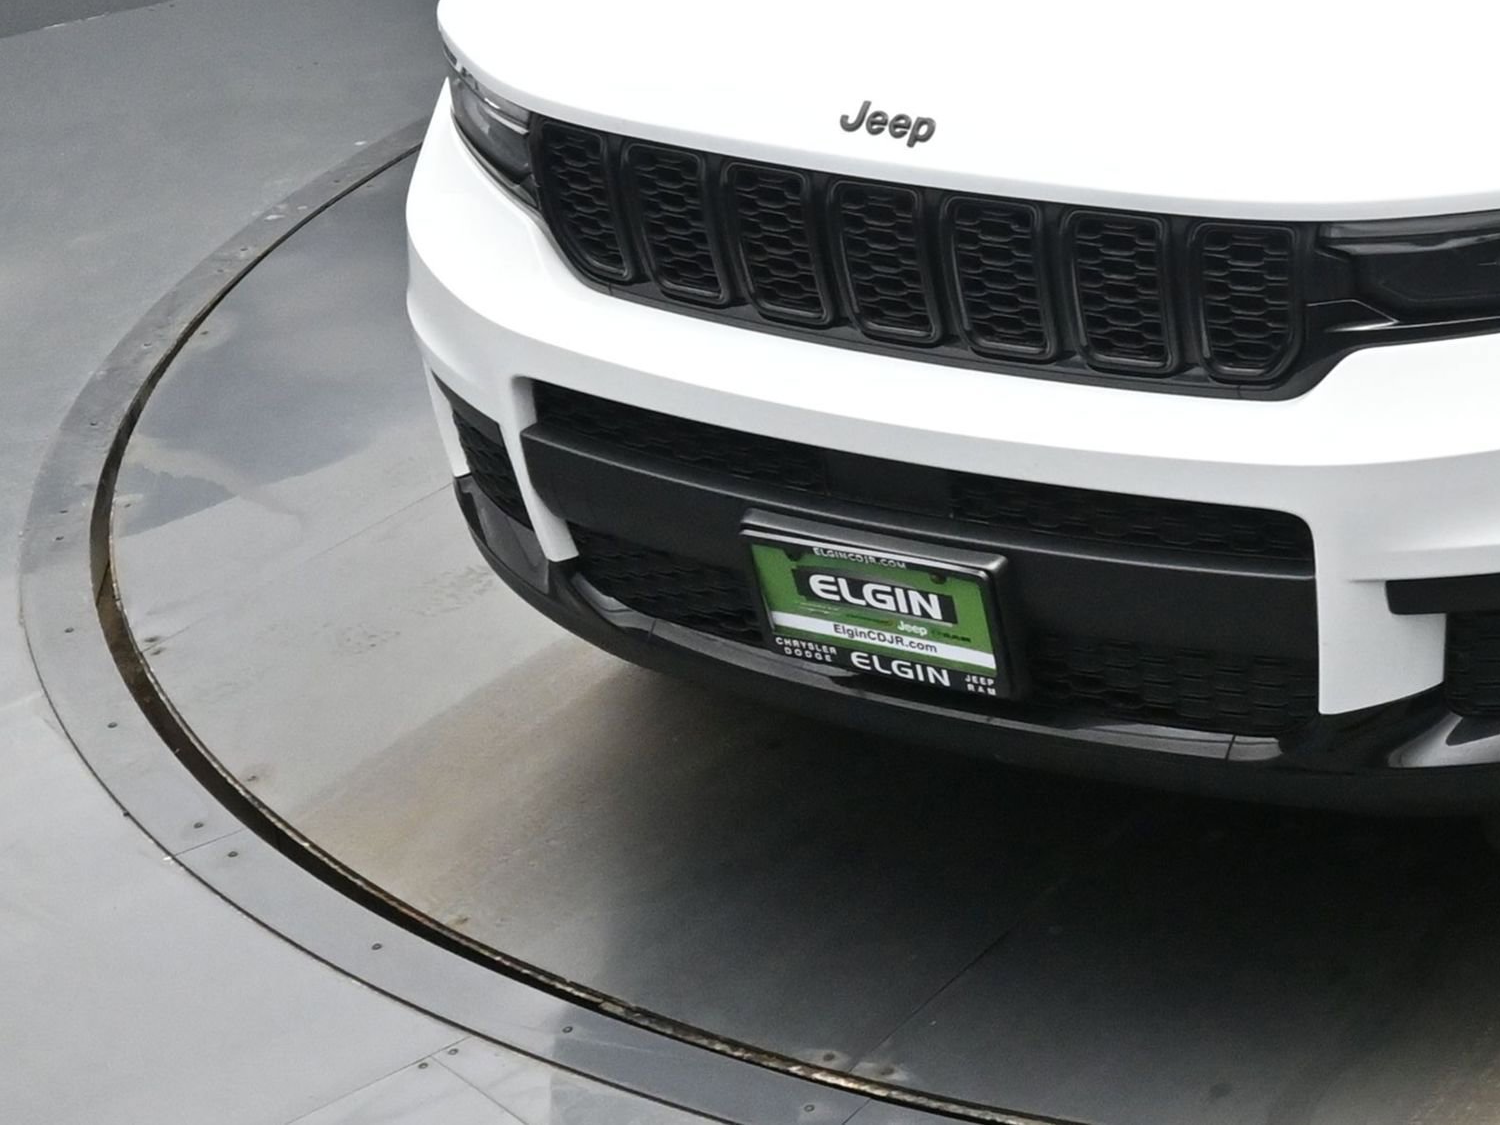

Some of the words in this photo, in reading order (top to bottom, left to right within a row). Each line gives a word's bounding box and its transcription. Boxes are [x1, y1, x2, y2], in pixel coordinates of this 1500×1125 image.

[840, 100, 936, 148] Jeep
[808, 574, 943, 620] ELGIN
[833, 623, 937, 653] ElginCDJR.com
[897, 620, 928, 637] Jeep
[775, 636, 837, 655] CHRYSLER
[784, 646, 832, 662] DODGE
[850, 651, 951, 687] ELGIN
[965, 674, 995, 686] JEEP
[967, 684, 997, 696] RAM
